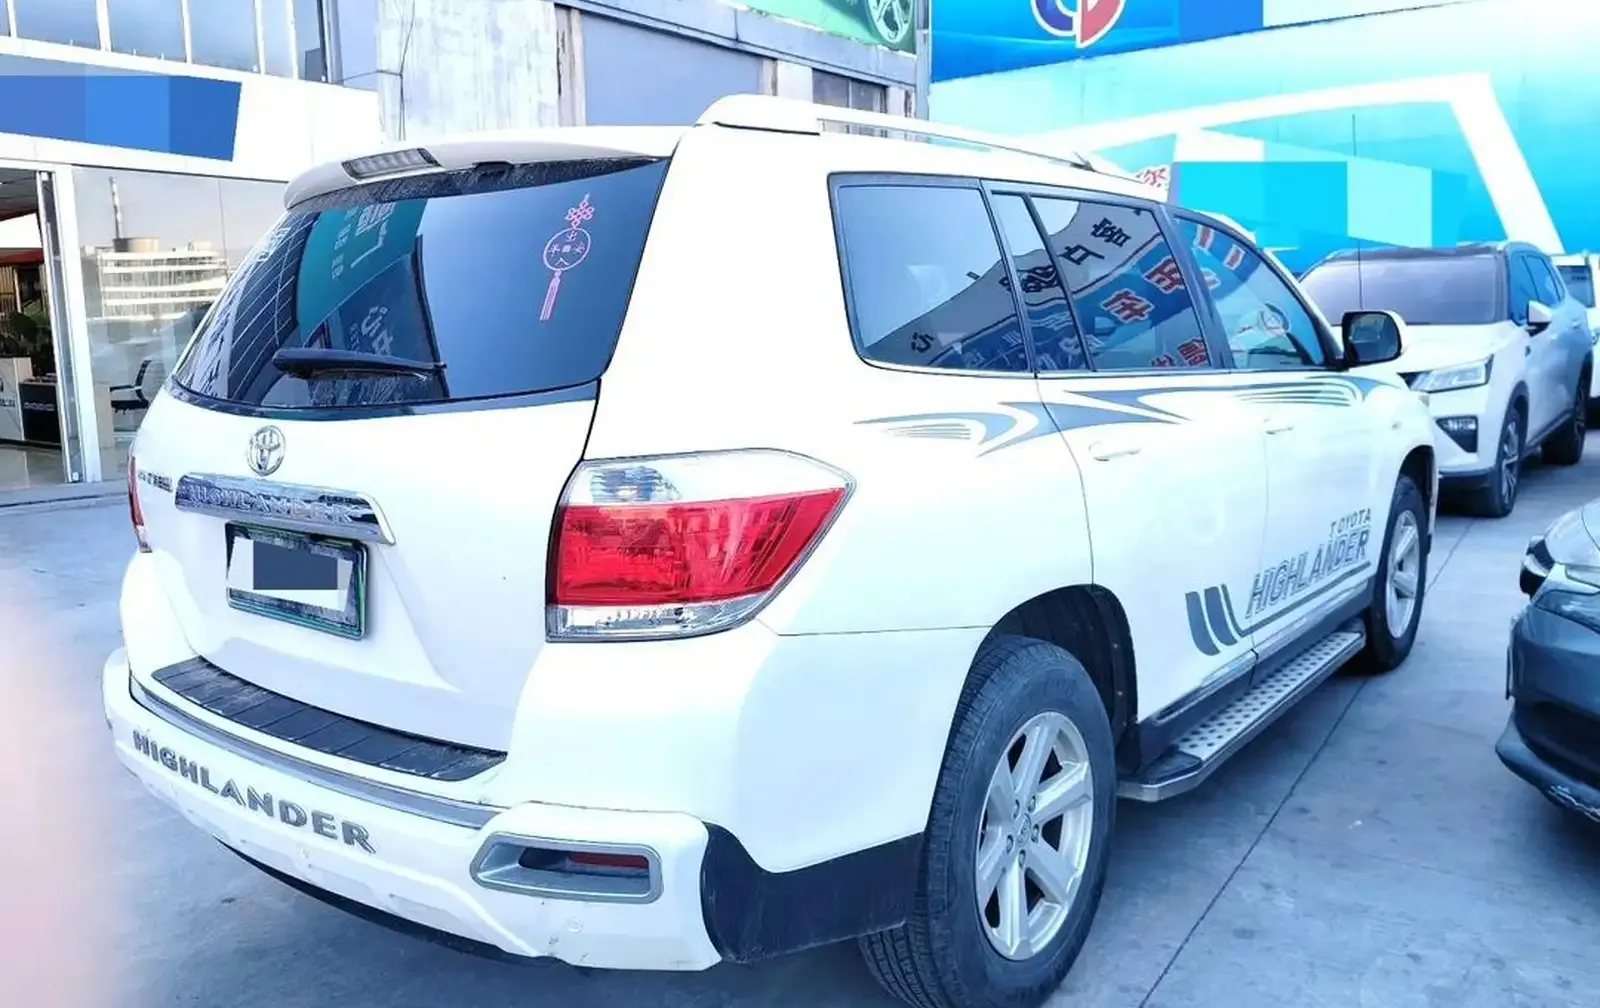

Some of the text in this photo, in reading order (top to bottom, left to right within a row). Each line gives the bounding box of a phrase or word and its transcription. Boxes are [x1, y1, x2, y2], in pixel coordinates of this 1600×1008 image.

[1328, 508, 1372, 539] TOYOTA
[1244, 527, 1371, 619] HIGHLANDER
[132, 729, 377, 855] HIGHLANDER
